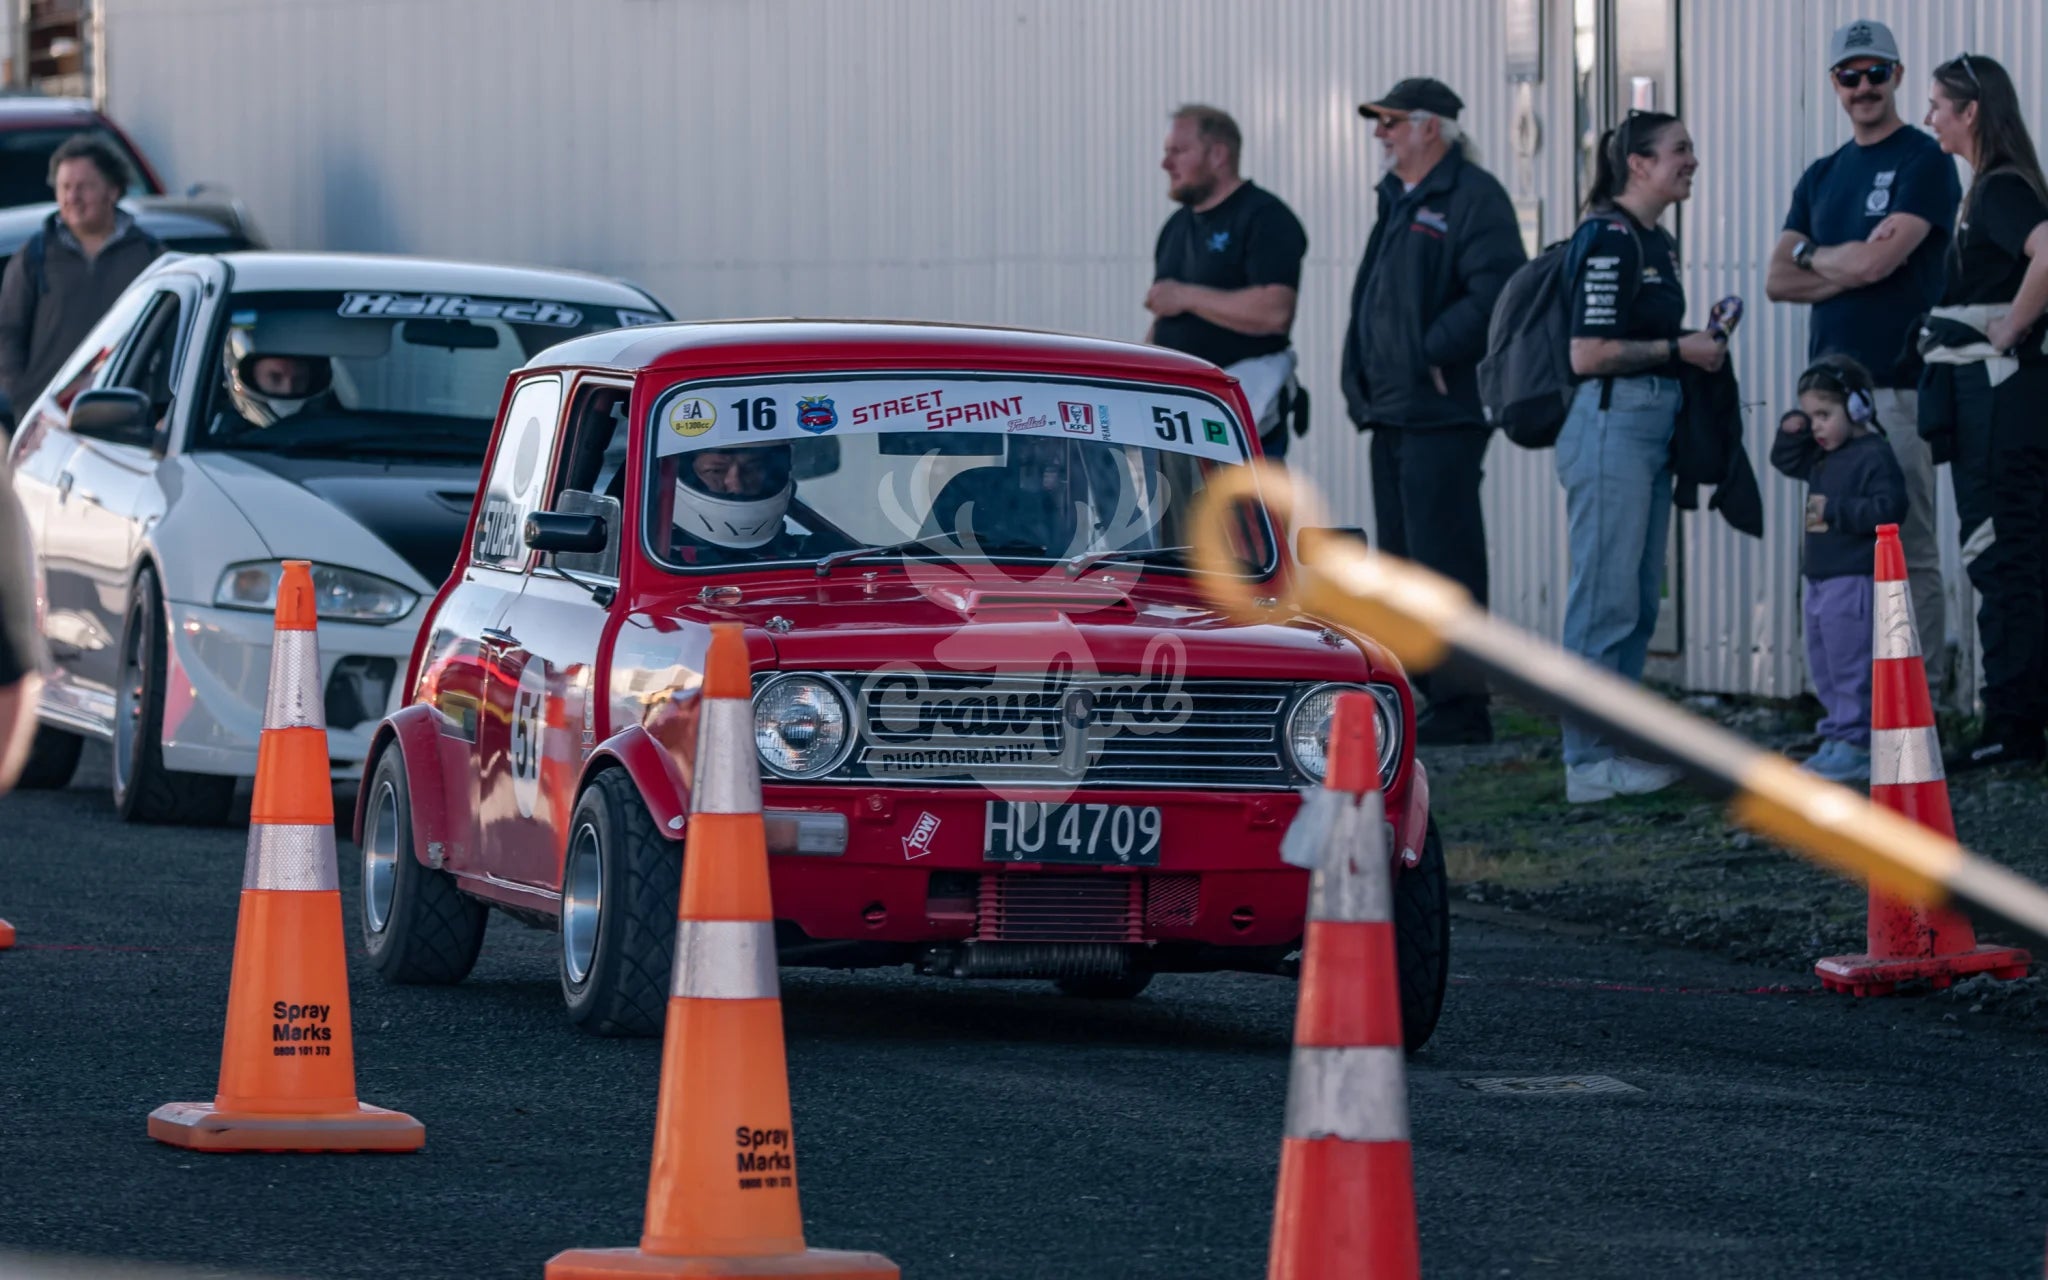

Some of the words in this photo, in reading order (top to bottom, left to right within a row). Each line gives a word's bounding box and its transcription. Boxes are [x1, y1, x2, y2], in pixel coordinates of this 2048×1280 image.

[346, 293, 578, 324] Haltech
[691, 400, 702, 419] A
[730, 397, 776, 431] 16
[852, 390, 943, 425] STREET
[927, 396, 1023, 430] SPRINT
[1069, 423, 1089, 431] KFC
[1152, 406, 1194, 445] 51
[1207, 422, 1223, 439] P
[516, 692, 541, 779] 51
[908, 815, 935, 849] TOW
[986, 800, 1047, 852] HU
[1057, 803, 1162, 855] 4709
[273, 1001, 330, 1023] Spray
[273, 1023, 331, 1041] Marks
[299, 1046, 313, 1056] 101
[736, 1126, 789, 1150] Spray
[737, 1151, 791, 1173] Marks
